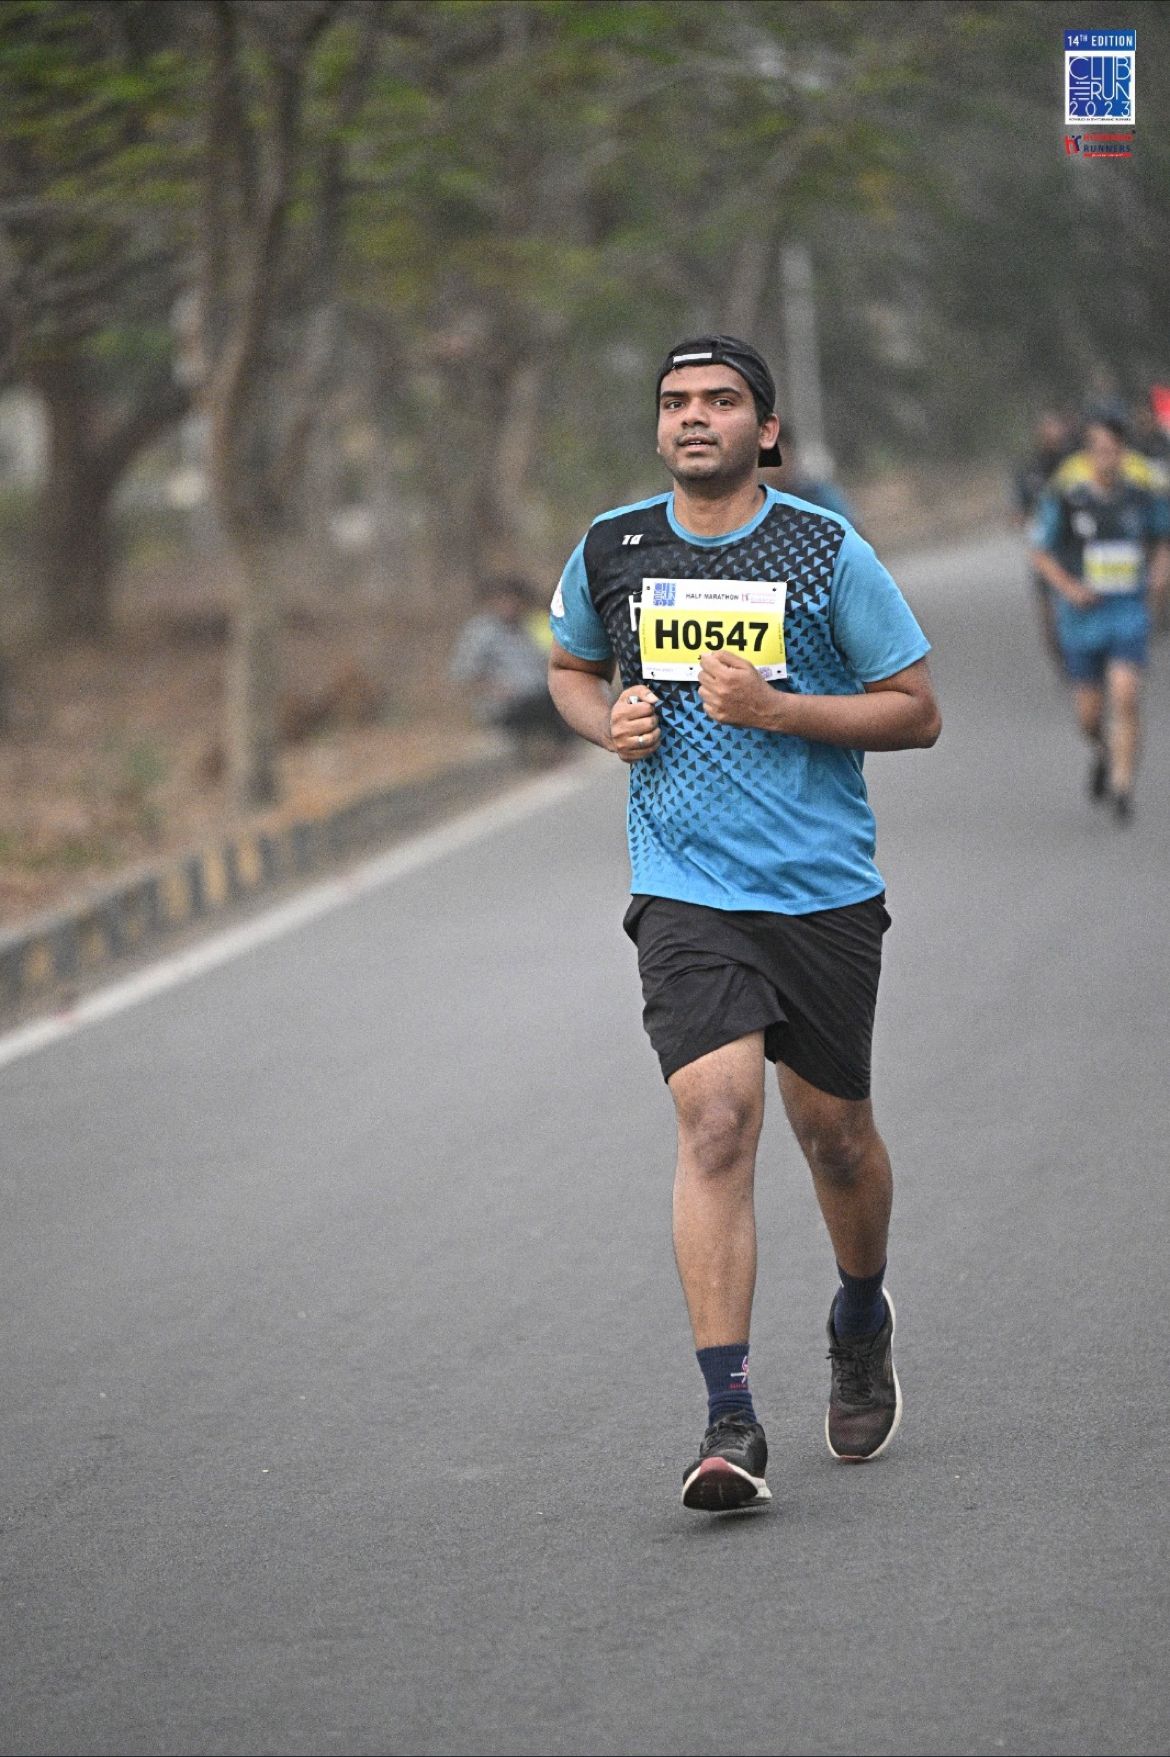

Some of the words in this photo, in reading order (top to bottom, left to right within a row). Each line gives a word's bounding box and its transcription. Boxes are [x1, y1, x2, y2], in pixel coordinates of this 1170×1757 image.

[685, 592, 702, 600] HALF
[703, 593, 739, 601] MARATHON
[655, 618, 769, 652] H0547
